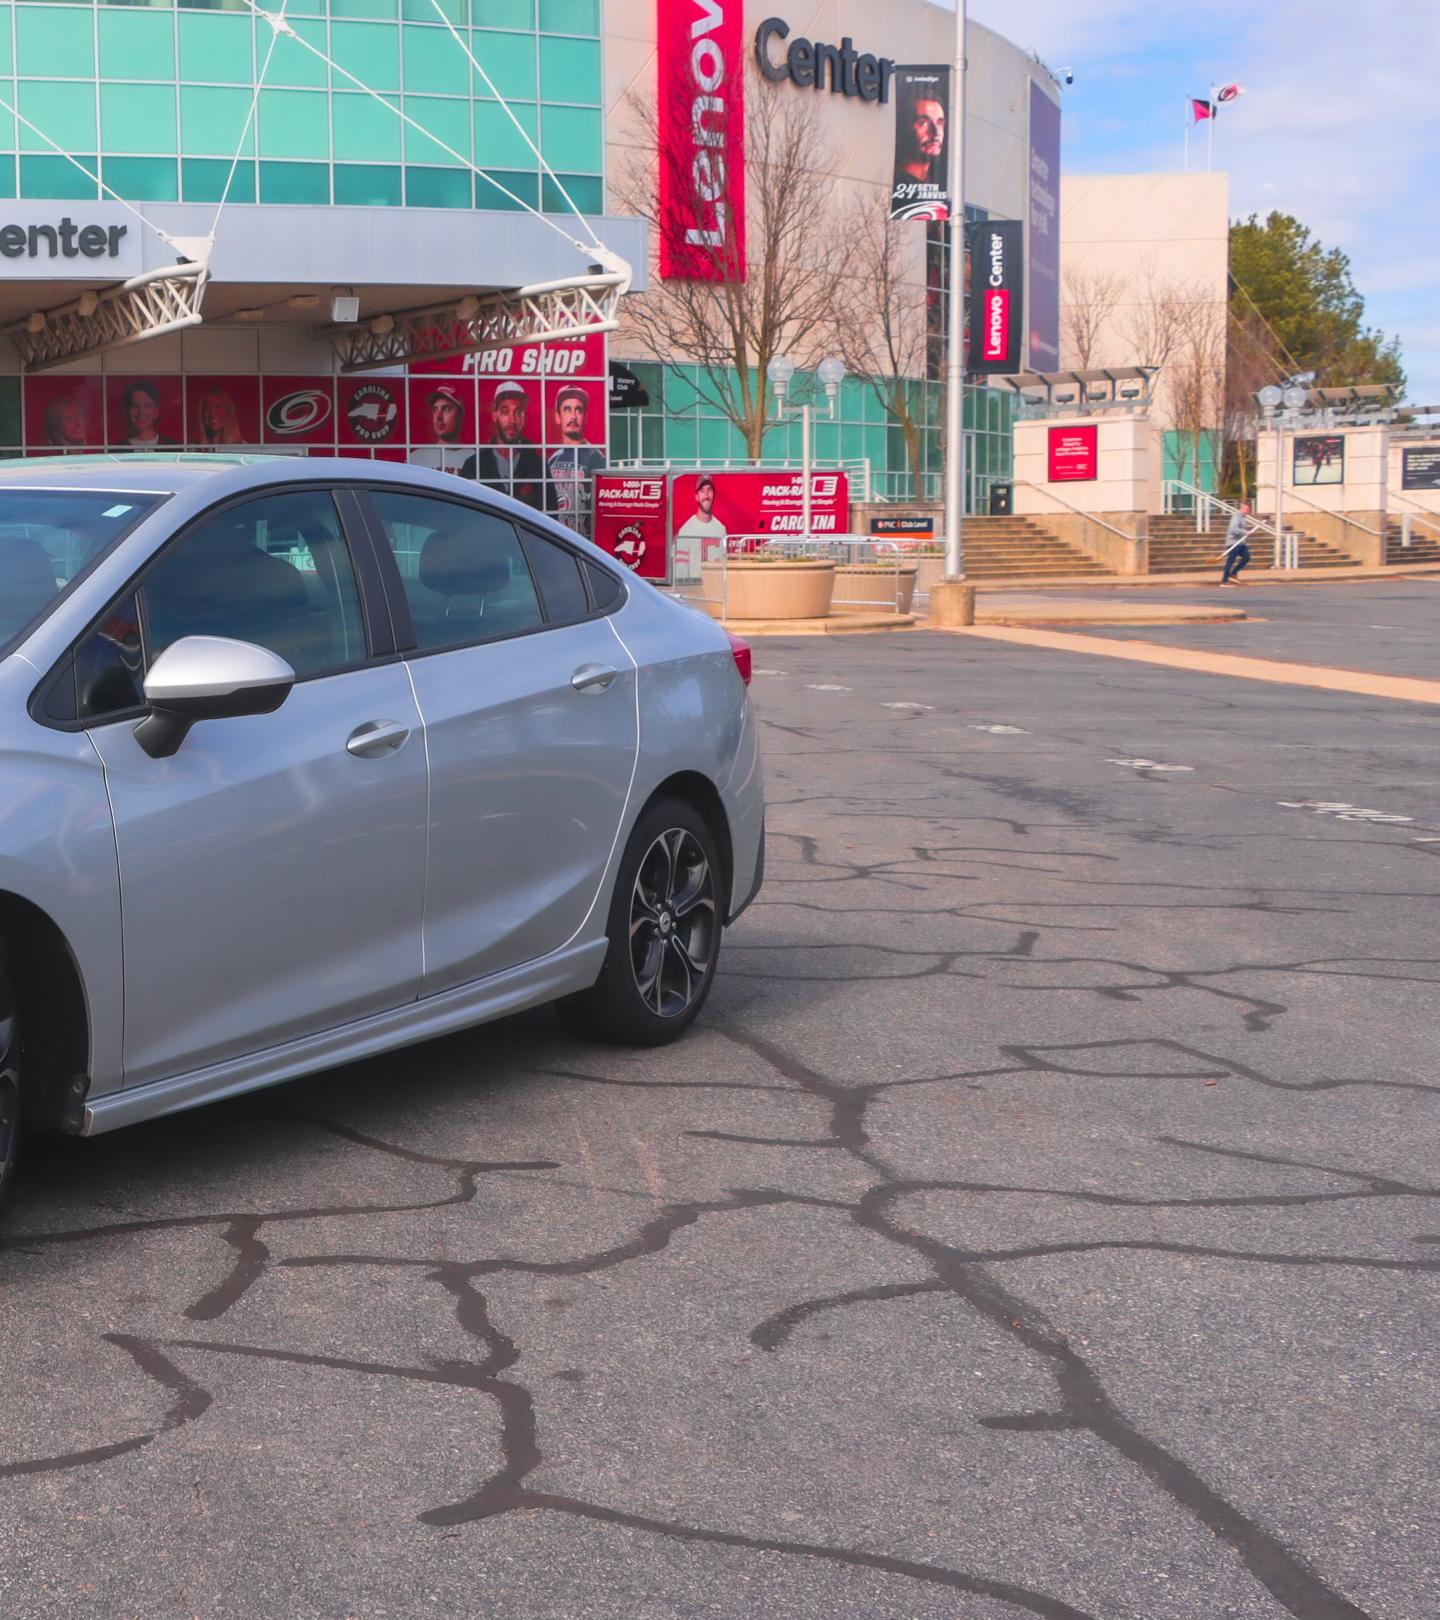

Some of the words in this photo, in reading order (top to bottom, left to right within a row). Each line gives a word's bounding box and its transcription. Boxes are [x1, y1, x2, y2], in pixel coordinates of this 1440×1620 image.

[754, 17, 896, 104] Center
[893, 183, 917, 199] 24
[918, 183, 939, 191] SETH
[916, 191, 948, 200] JARVIS
[989, 233, 1003, 287] Center
[987, 295, 1003, 355] Lenovo
[462, 349, 513, 373] PRO
[521, 348, 586, 373] SHOP
[353, 385, 390, 401] CAROLINA
[371, 424, 390, 440] SHOP
[598, 489, 641, 499] PACK-RAT
[762, 485, 807, 497] PACK-RA
[771, 514, 835, 531] CAROINA
